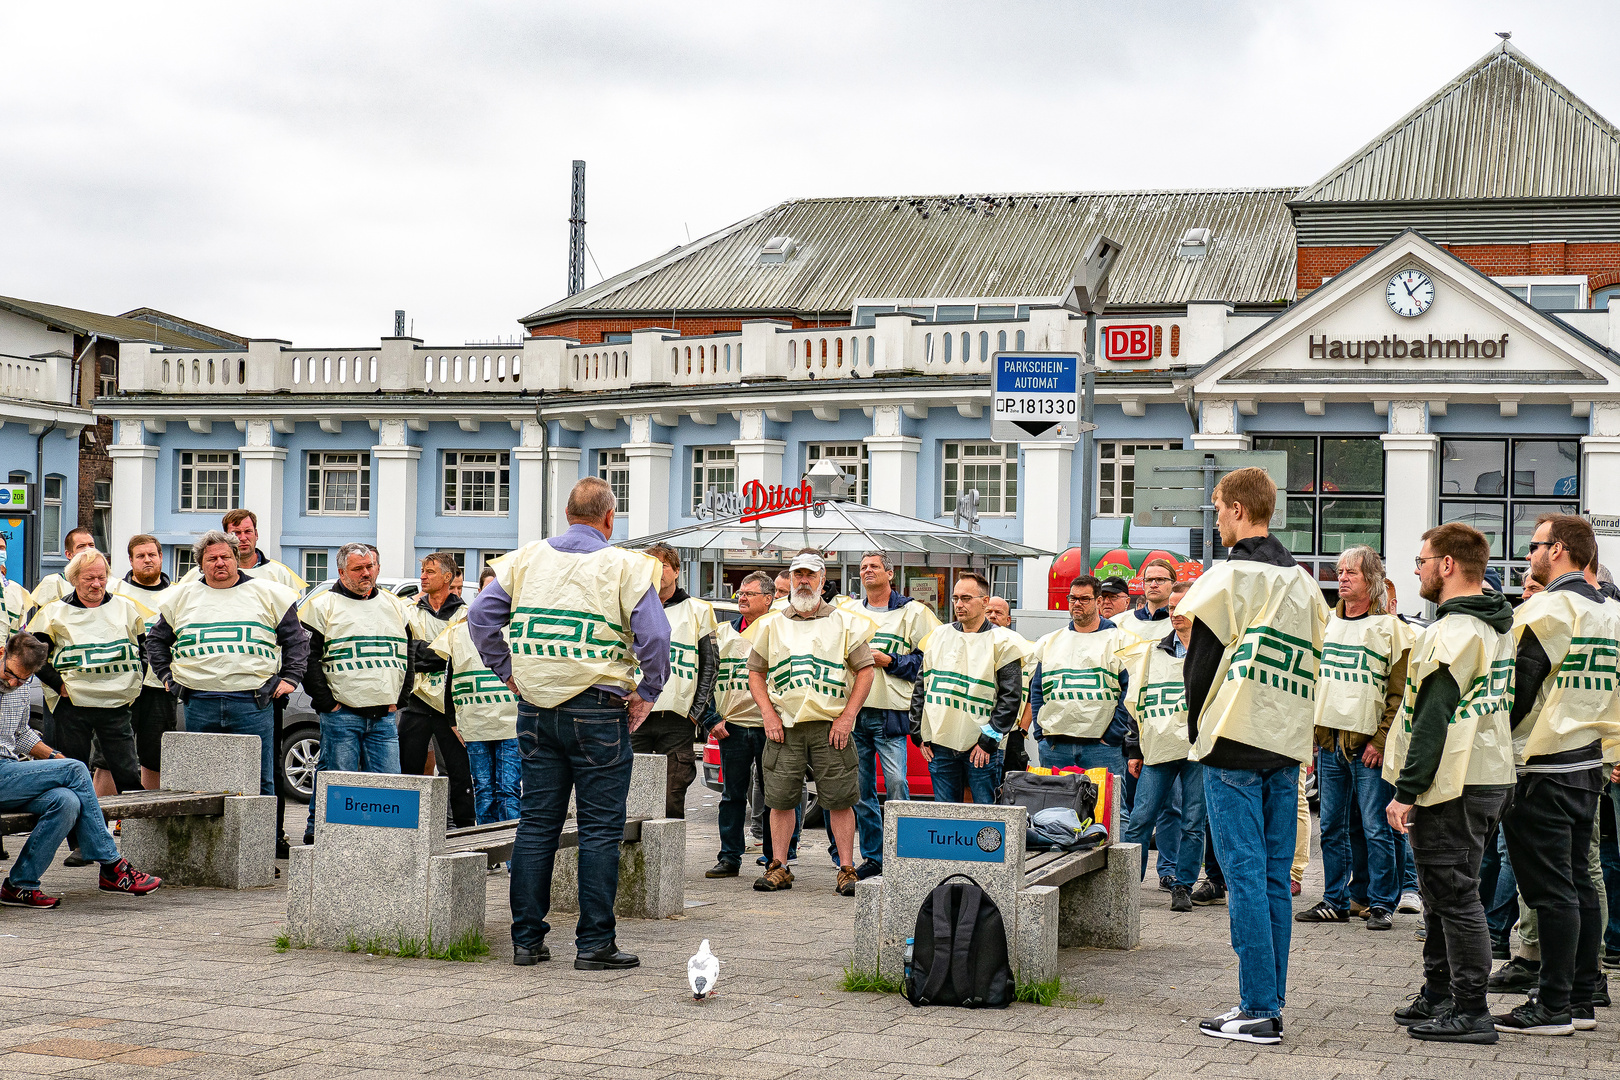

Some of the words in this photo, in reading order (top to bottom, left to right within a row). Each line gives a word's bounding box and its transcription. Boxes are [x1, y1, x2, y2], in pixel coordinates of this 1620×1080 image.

[1111, 330, 1147, 355] DB
[1309, 332, 1509, 364] Hauptbahnhof
[1004, 360, 1069, 374] PARKSCHEIN-
[1014, 376, 1059, 389] AUTOMAT
[13, 493, 24, 501] ZOB
[742, 479, 813, 515] Ditsch
[344, 797, 400, 815] Bremen
[927, 829, 974, 847] Turku
